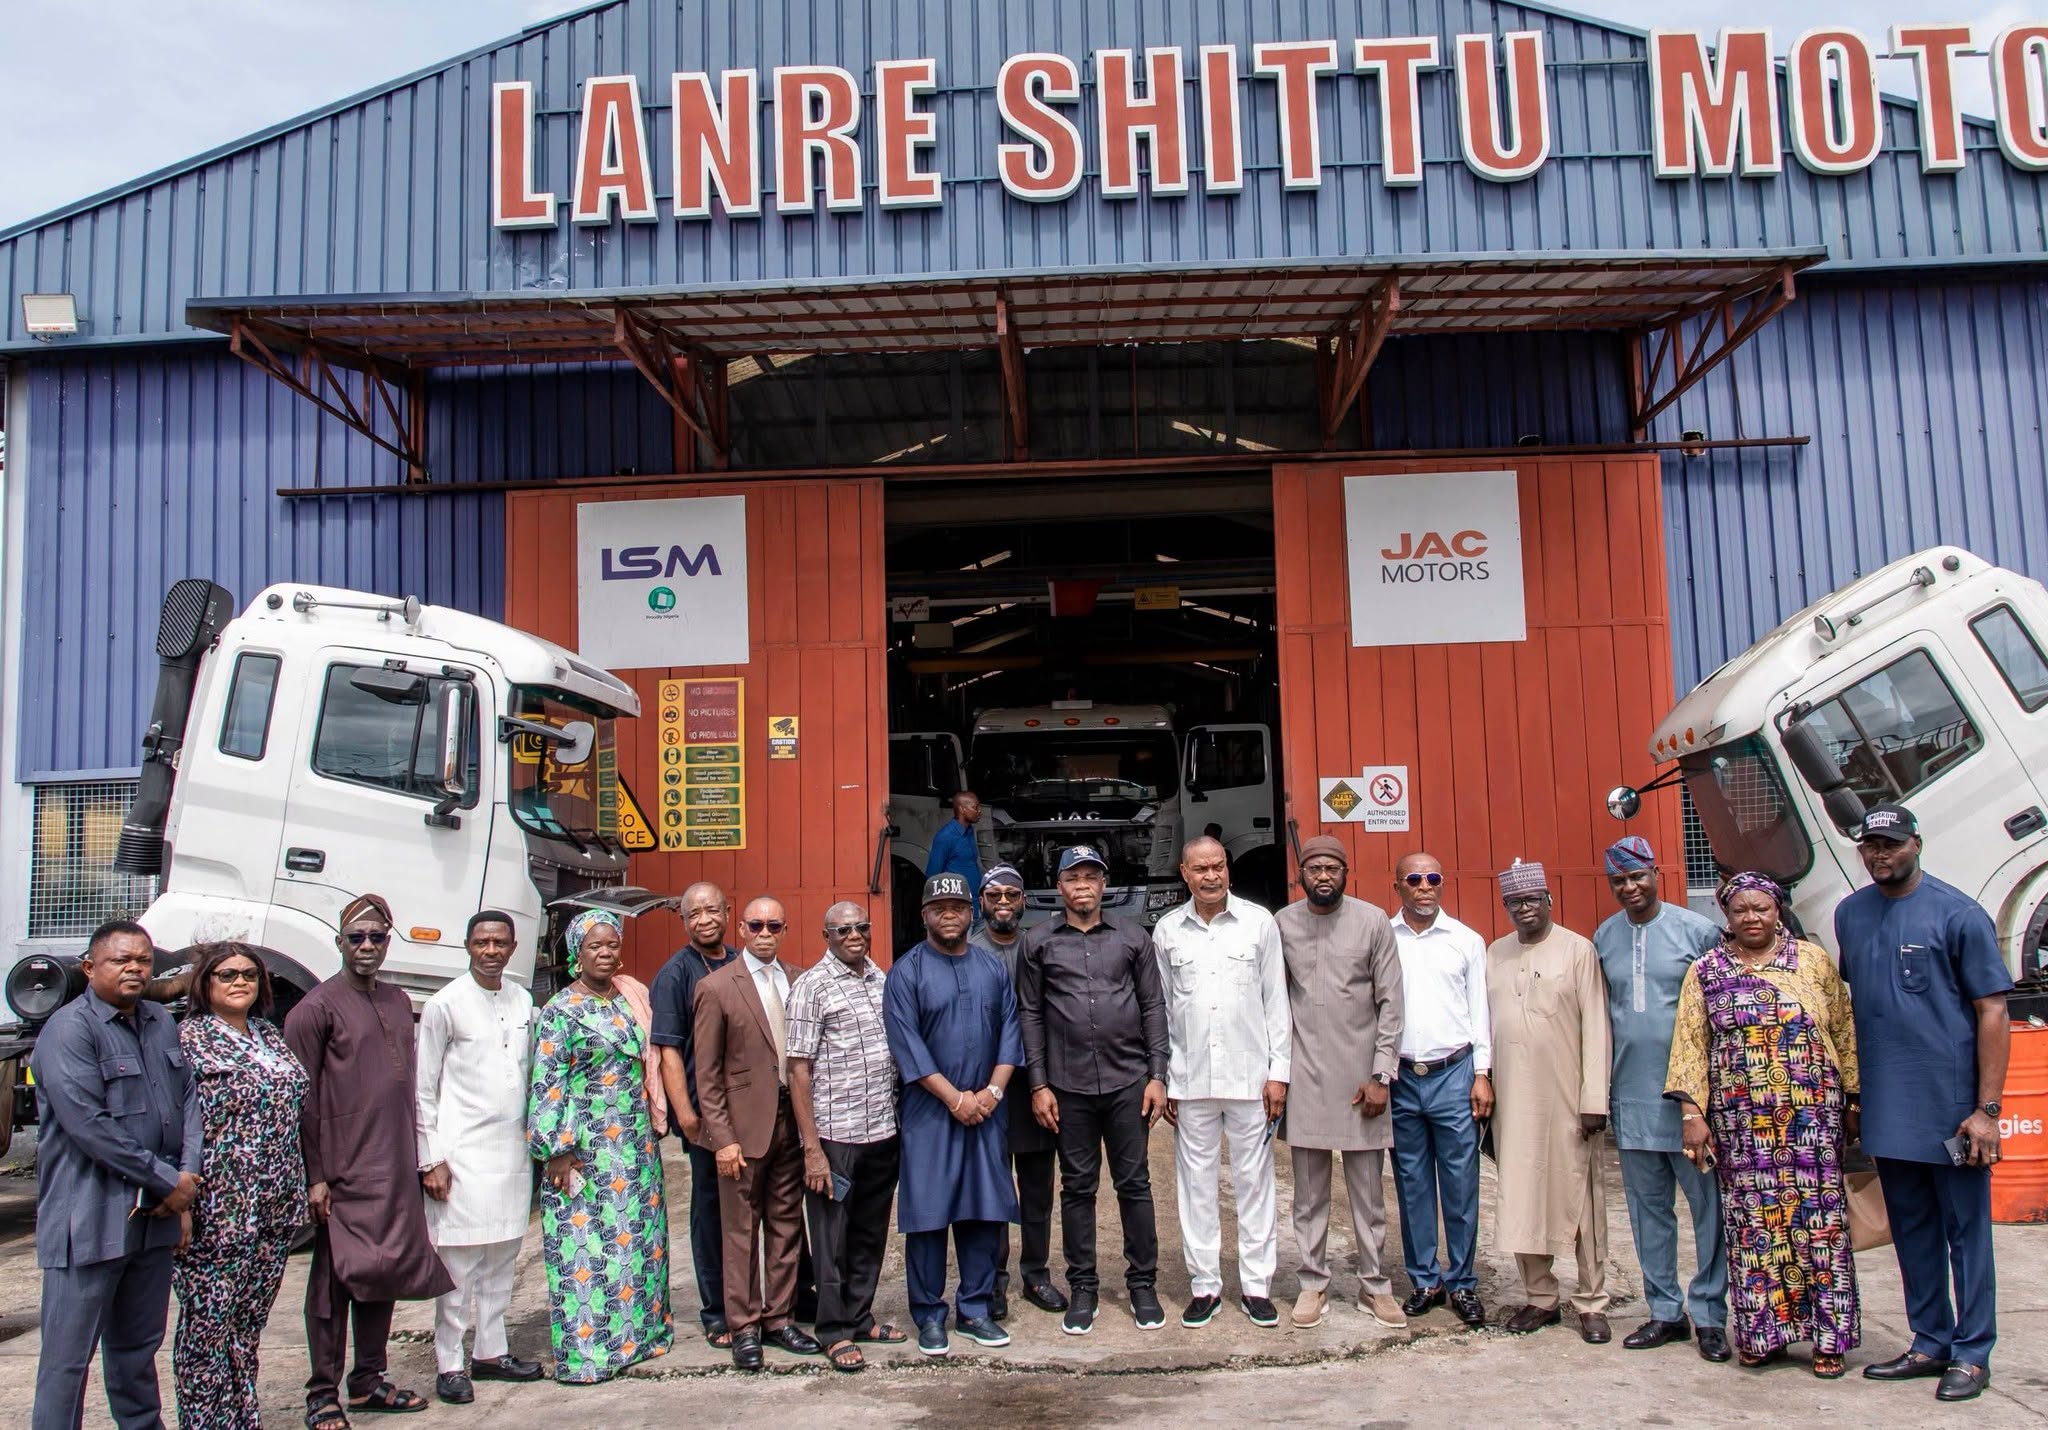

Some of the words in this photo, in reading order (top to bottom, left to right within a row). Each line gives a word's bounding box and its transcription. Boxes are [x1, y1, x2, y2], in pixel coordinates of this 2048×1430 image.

[493, 58, 944, 230] LANRE
[997, 28, 1551, 203] SHITTU
[1380, 529, 1489, 561] JAC
[601, 543, 722, 581] LSM
[1381, 561, 1490, 584] MOTORS
[688, 708, 699, 717] NO
[700, 707, 736, 717] PICTURES
[688, 731, 698, 740] NO
[932, 878, 964, 896] LSM
